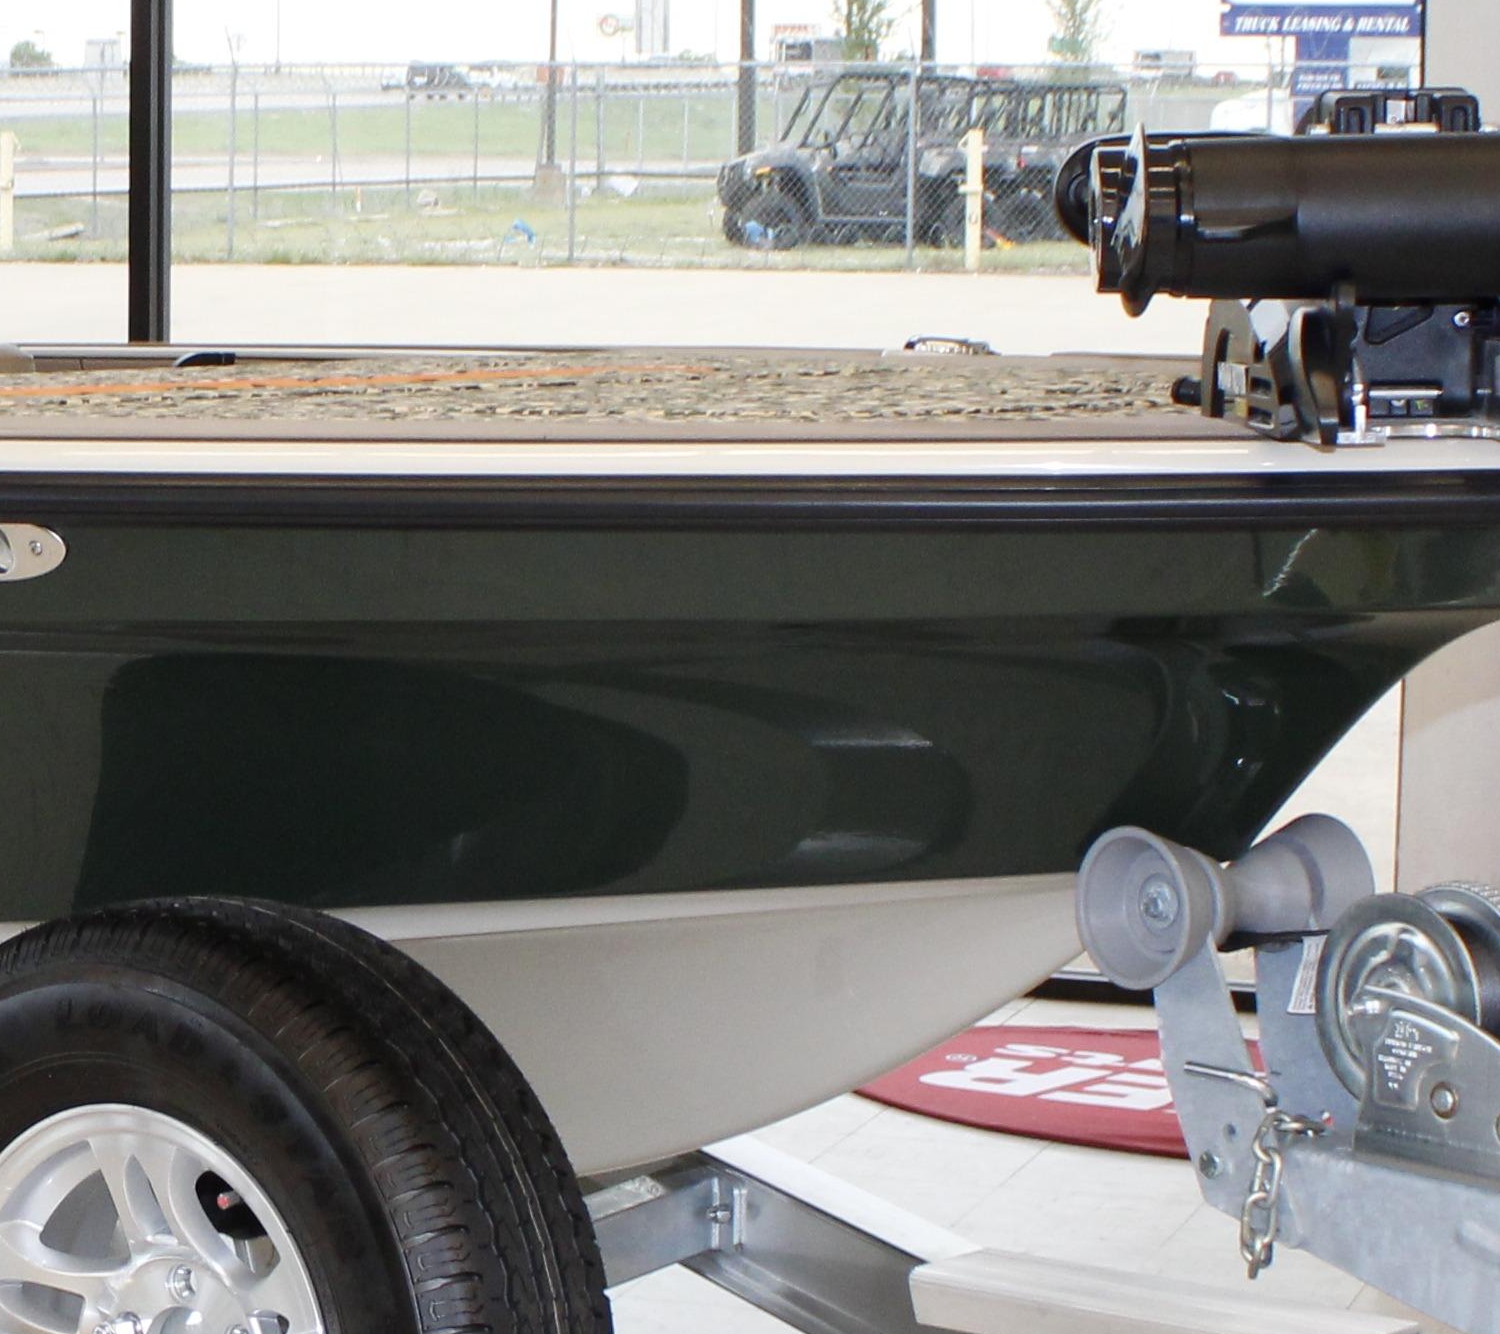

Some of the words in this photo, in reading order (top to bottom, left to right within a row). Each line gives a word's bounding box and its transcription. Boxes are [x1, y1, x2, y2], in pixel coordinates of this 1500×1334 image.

[1234, 16, 1279, 33] TRUCK
[1282, 15, 1341, 33] LEASING
[1356, 16, 1411, 33] RENTAL
